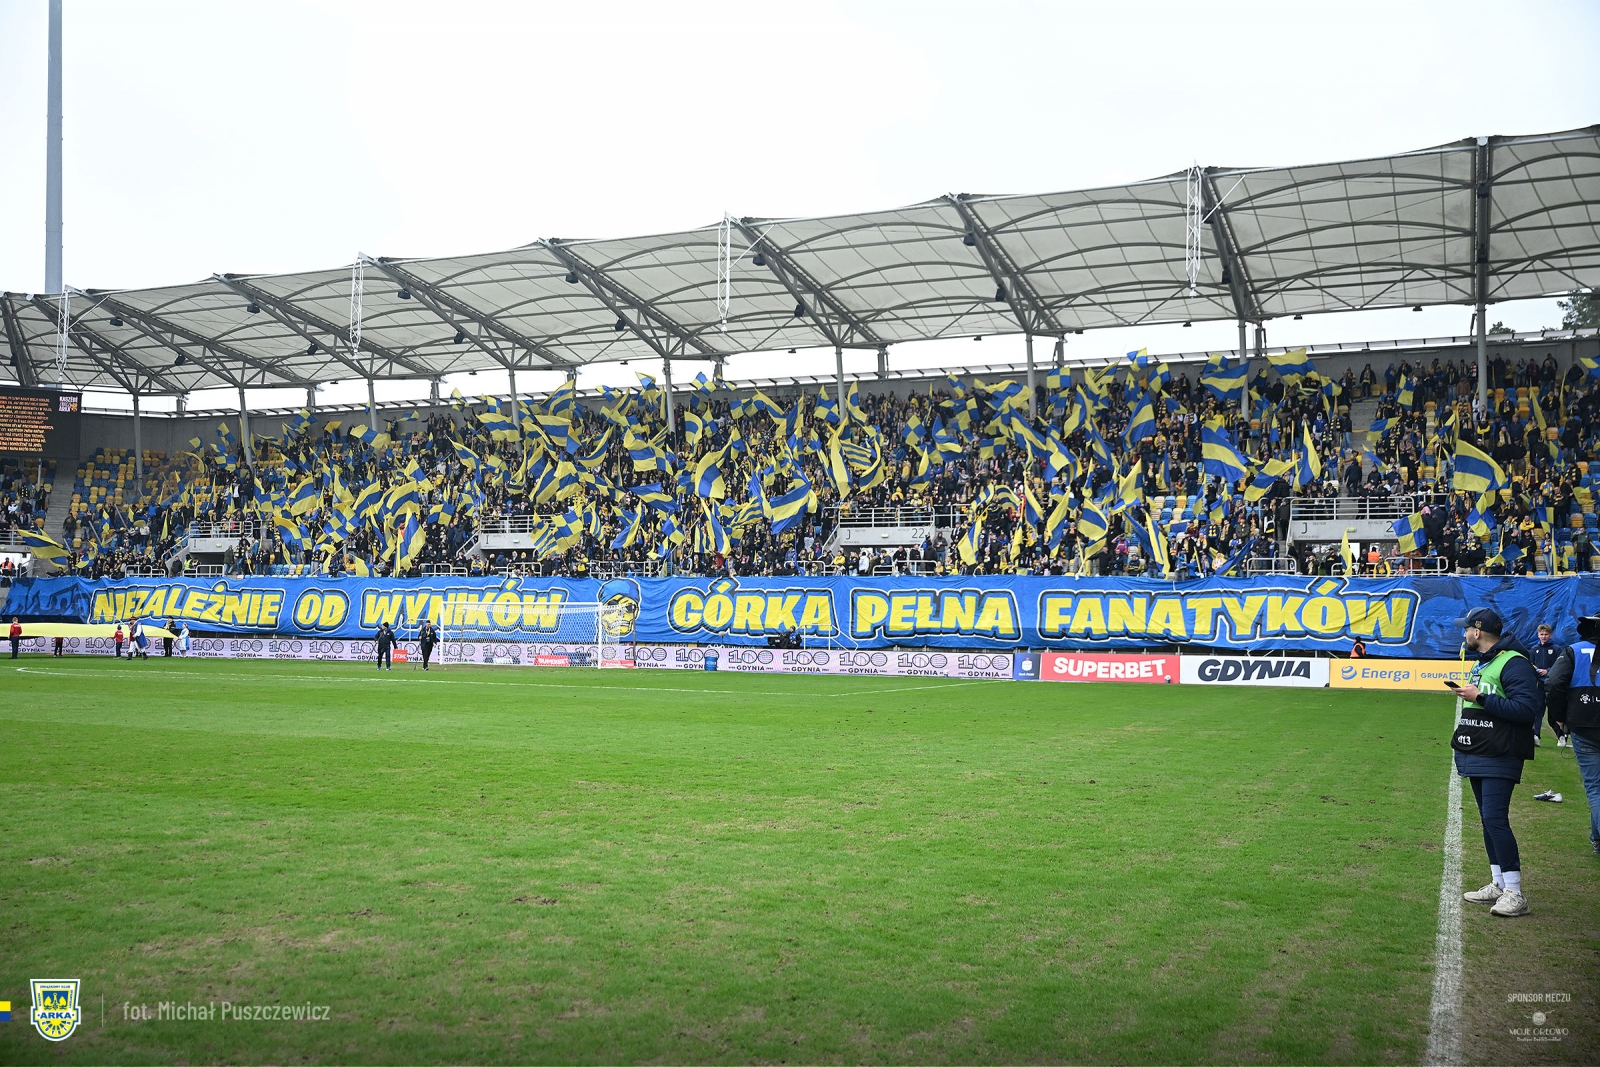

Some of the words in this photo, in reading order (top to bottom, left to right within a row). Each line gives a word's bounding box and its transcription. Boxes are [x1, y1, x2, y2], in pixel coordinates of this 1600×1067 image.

[911, 527, 925, 539] 22
[1386, 520, 1394, 533] 2
[93, 585, 280, 624] NIEZALEŻNIE
[298, 594, 345, 626] OD
[363, 580, 562, 627] WYNIKÓW
[674, 582, 832, 630] GÓRKA
[857, 596, 1015, 634] PEŁNA
[1046, 580, 1411, 638] FANATYKÓW
[193, 639, 225, 651] 100
[231, 640, 264, 652] 100
[269, 640, 303, 653] 100
[310, 641, 345, 654] 100
[729, 650, 774, 664] 100
[783, 651, 830, 665] 100
[839, 651, 888, 667] 100
[897, 653, 948, 669] 100
[957, 654, 1010, 671] 100
[1053, 656, 1166, 679] SUPERBET
[1197, 659, 1311, 682] GDYNIA
[1361, 667, 1411, 682] Energa
